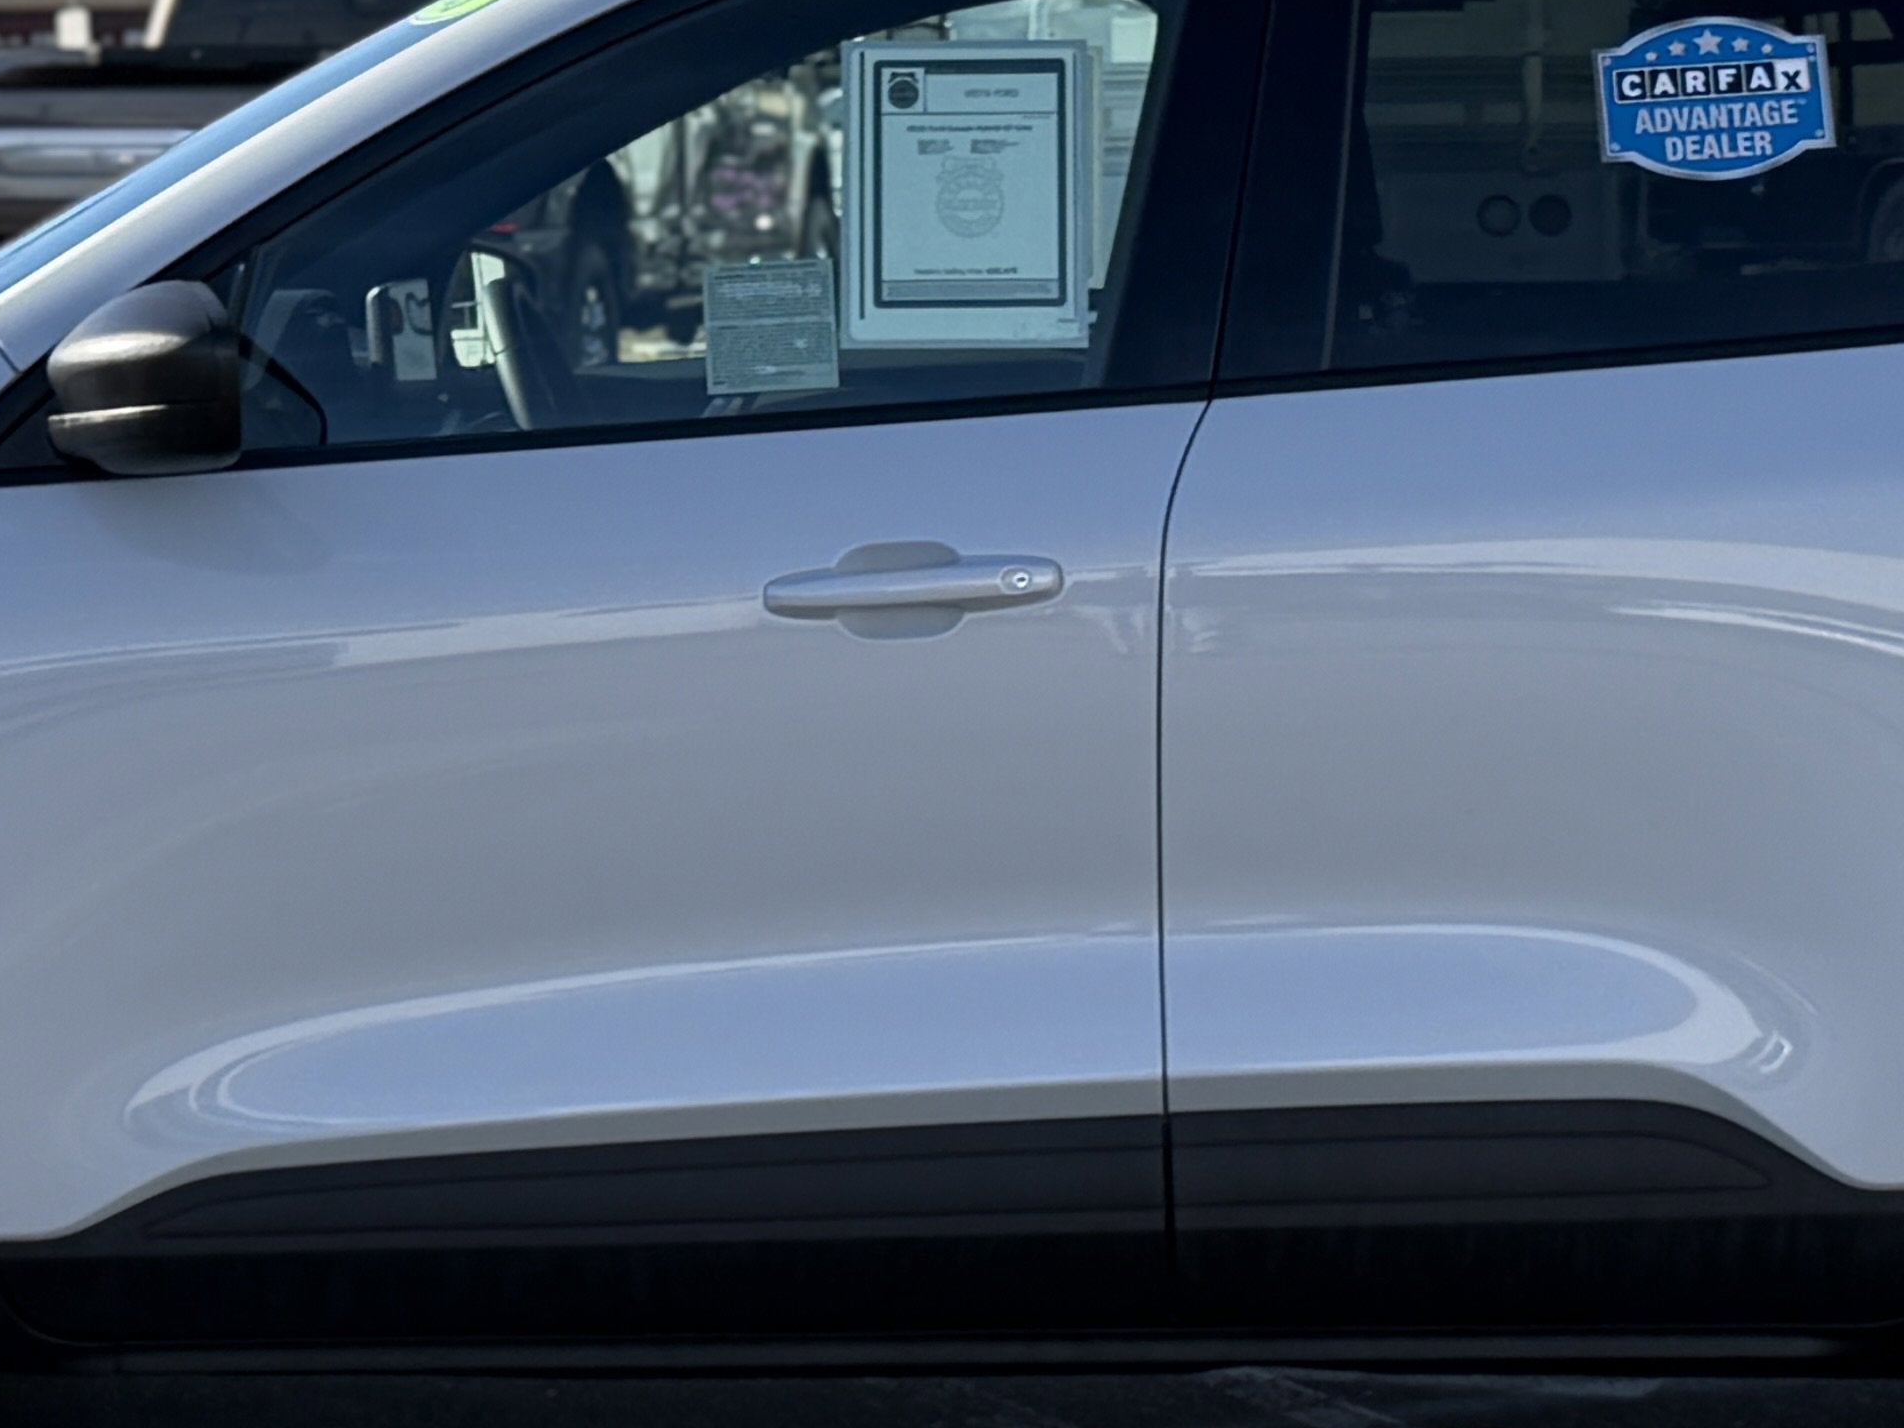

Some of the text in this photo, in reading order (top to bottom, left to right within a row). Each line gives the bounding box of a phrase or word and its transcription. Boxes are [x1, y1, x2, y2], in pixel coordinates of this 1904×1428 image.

[1621, 67, 1802, 98] CARFAX
[1635, 99, 1799, 134] ADVANTAGE
[1665, 131, 1773, 161] DEALER
